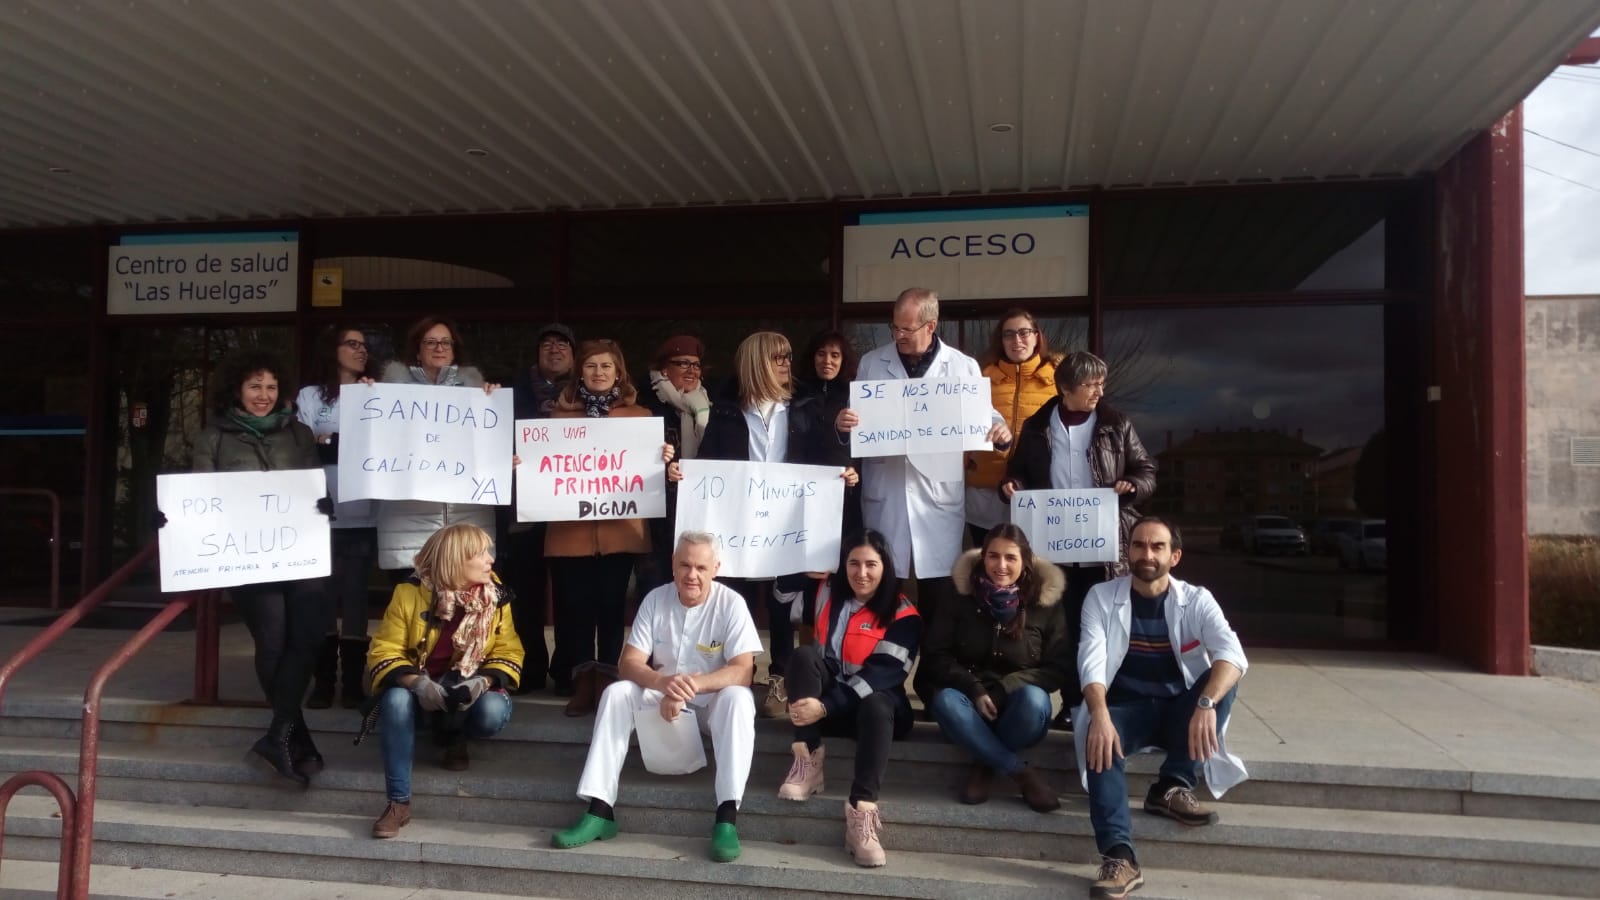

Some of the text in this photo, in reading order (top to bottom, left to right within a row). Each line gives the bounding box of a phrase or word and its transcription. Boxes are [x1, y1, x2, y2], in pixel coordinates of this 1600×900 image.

[890, 232, 1036, 259] ACCESO
[116, 252, 289, 274] Centro de salud
[860, 383, 978, 399] SE NOS MUERE
[360, 397, 498, 429] SANIDAD
[913, 402, 928, 412] LA
[426, 433, 440, 443] DE
[523, 426, 587, 443] POR UNA
[858, 429, 912, 444] SANIDAD
[918, 427, 932, 436] DE
[472, 476, 499, 504] YA
[692, 476, 725, 500] 10
[182, 494, 291, 517] POR TU
[1018, 496, 1101, 509] LA SANIDAD
[755, 510, 770, 518] POR
[1047, 514, 1088, 525] NO ES
[197, 526, 297, 556] SALUD
[1048, 537, 1106, 551] NEGOCIO
[218, 564, 260, 573] PRIMARIA
